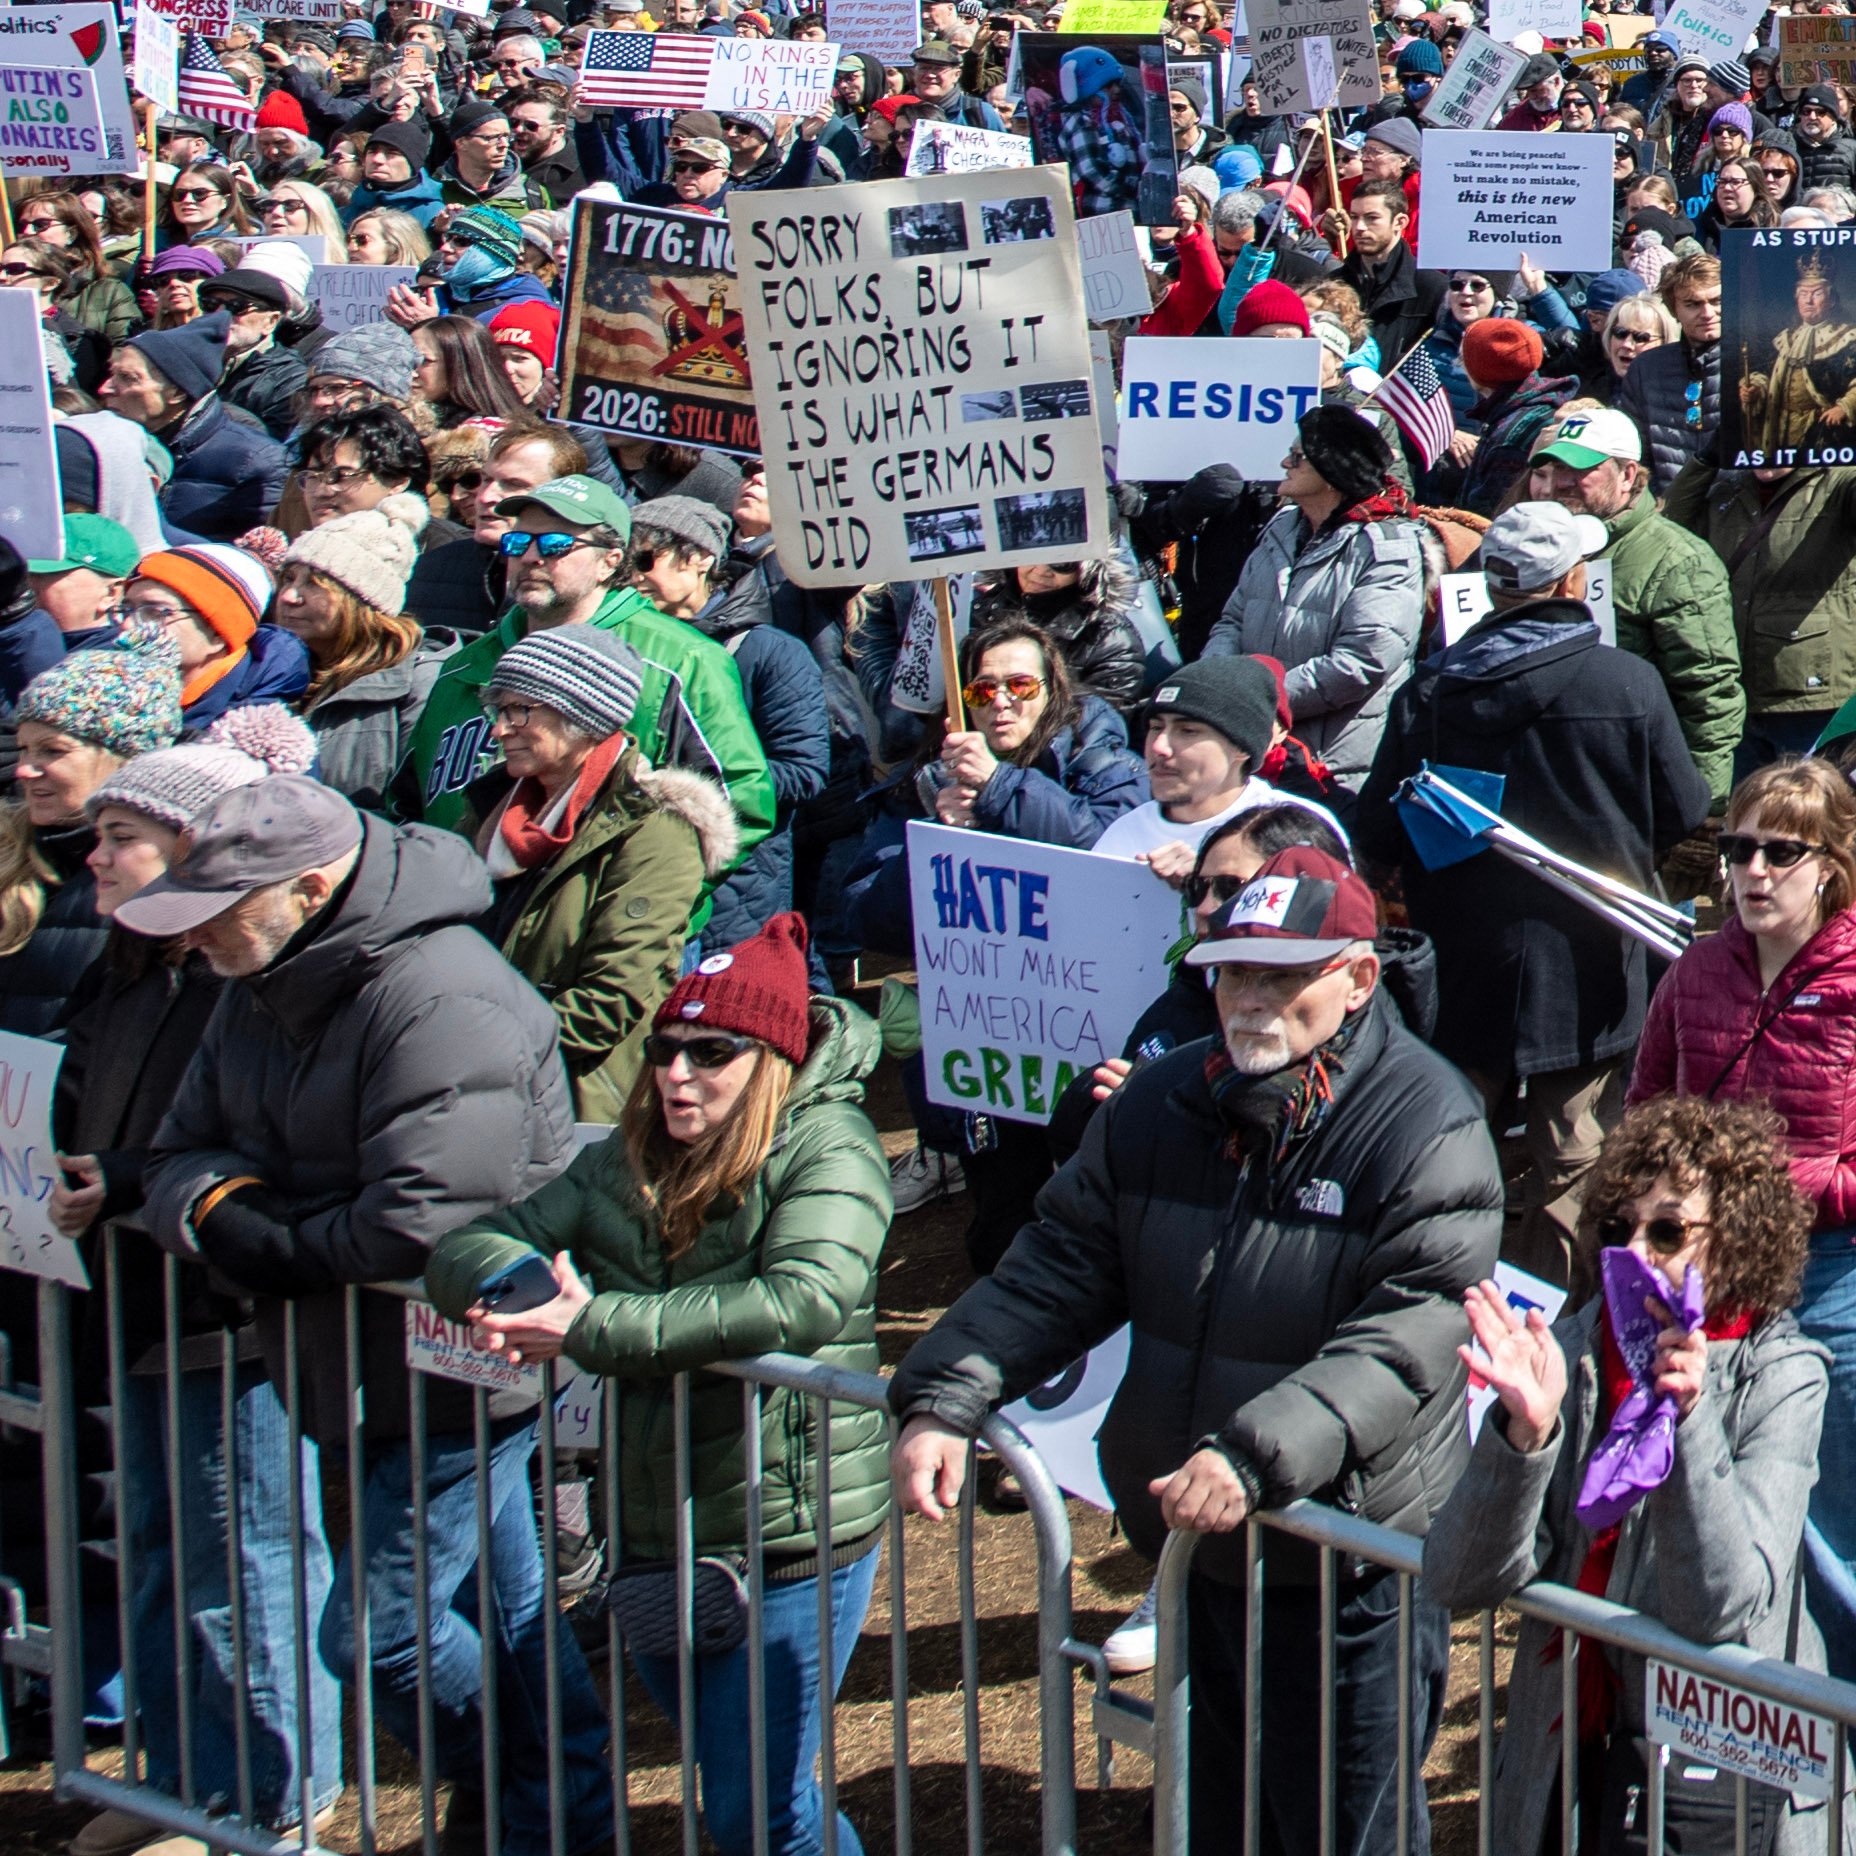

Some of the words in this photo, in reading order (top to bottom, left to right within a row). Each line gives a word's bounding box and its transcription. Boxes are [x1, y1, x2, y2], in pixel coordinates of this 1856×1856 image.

[1259, 28, 1283, 41] NO
[1286, 19, 1359, 40] DICTATORS
[1674, 9, 1733, 47] Politics
[717, 43, 751, 62] NO
[762, 46, 831, 64] KINGS
[1255, 43, 1294, 70] LIBERTY
[744, 65, 767, 85] IN
[777, 66, 827, 89] THE
[1464, 77, 1486, 97] NOW
[9, 99, 69, 123] ALSO
[1273, 87, 1299, 108] ALL
[1456, 92, 1473, 109] AND
[1458, 190, 1488, 203] this
[1492, 191, 1506, 203] is
[1511, 192, 1536, 204] the
[1542, 195, 1576, 205] new
[1474, 211, 1557, 224] American
[752, 212, 862, 271] SORRY
[1469, 230, 1562, 244] Revolution
[1751, 230, 1789, 247] AS
[762, 273, 893, 330] FOLKS,
[917, 258, 991, 317] BUT
[769, 324, 971, 392] IGNORING
[1001, 315, 1043, 367] IT
[1128, 380, 1317, 424] RESIST
[781, 399, 827, 450] IS
[844, 386, 953, 445] WHAT
[1735, 449, 1769, 468] AS
[1776, 449, 1796, 466] IT
[787, 457, 848, 512] THE
[872, 434, 1054, 502] GERMANS
[801, 517, 871, 570] DID
[931, 854, 1049, 942] HATE
[921, 934, 1006, 980] WONT
[1019, 947, 1100, 993] MAKE
[935, 985, 1108, 1066] AMERICA
[1656, 1662, 1829, 1761] NATIONAL
